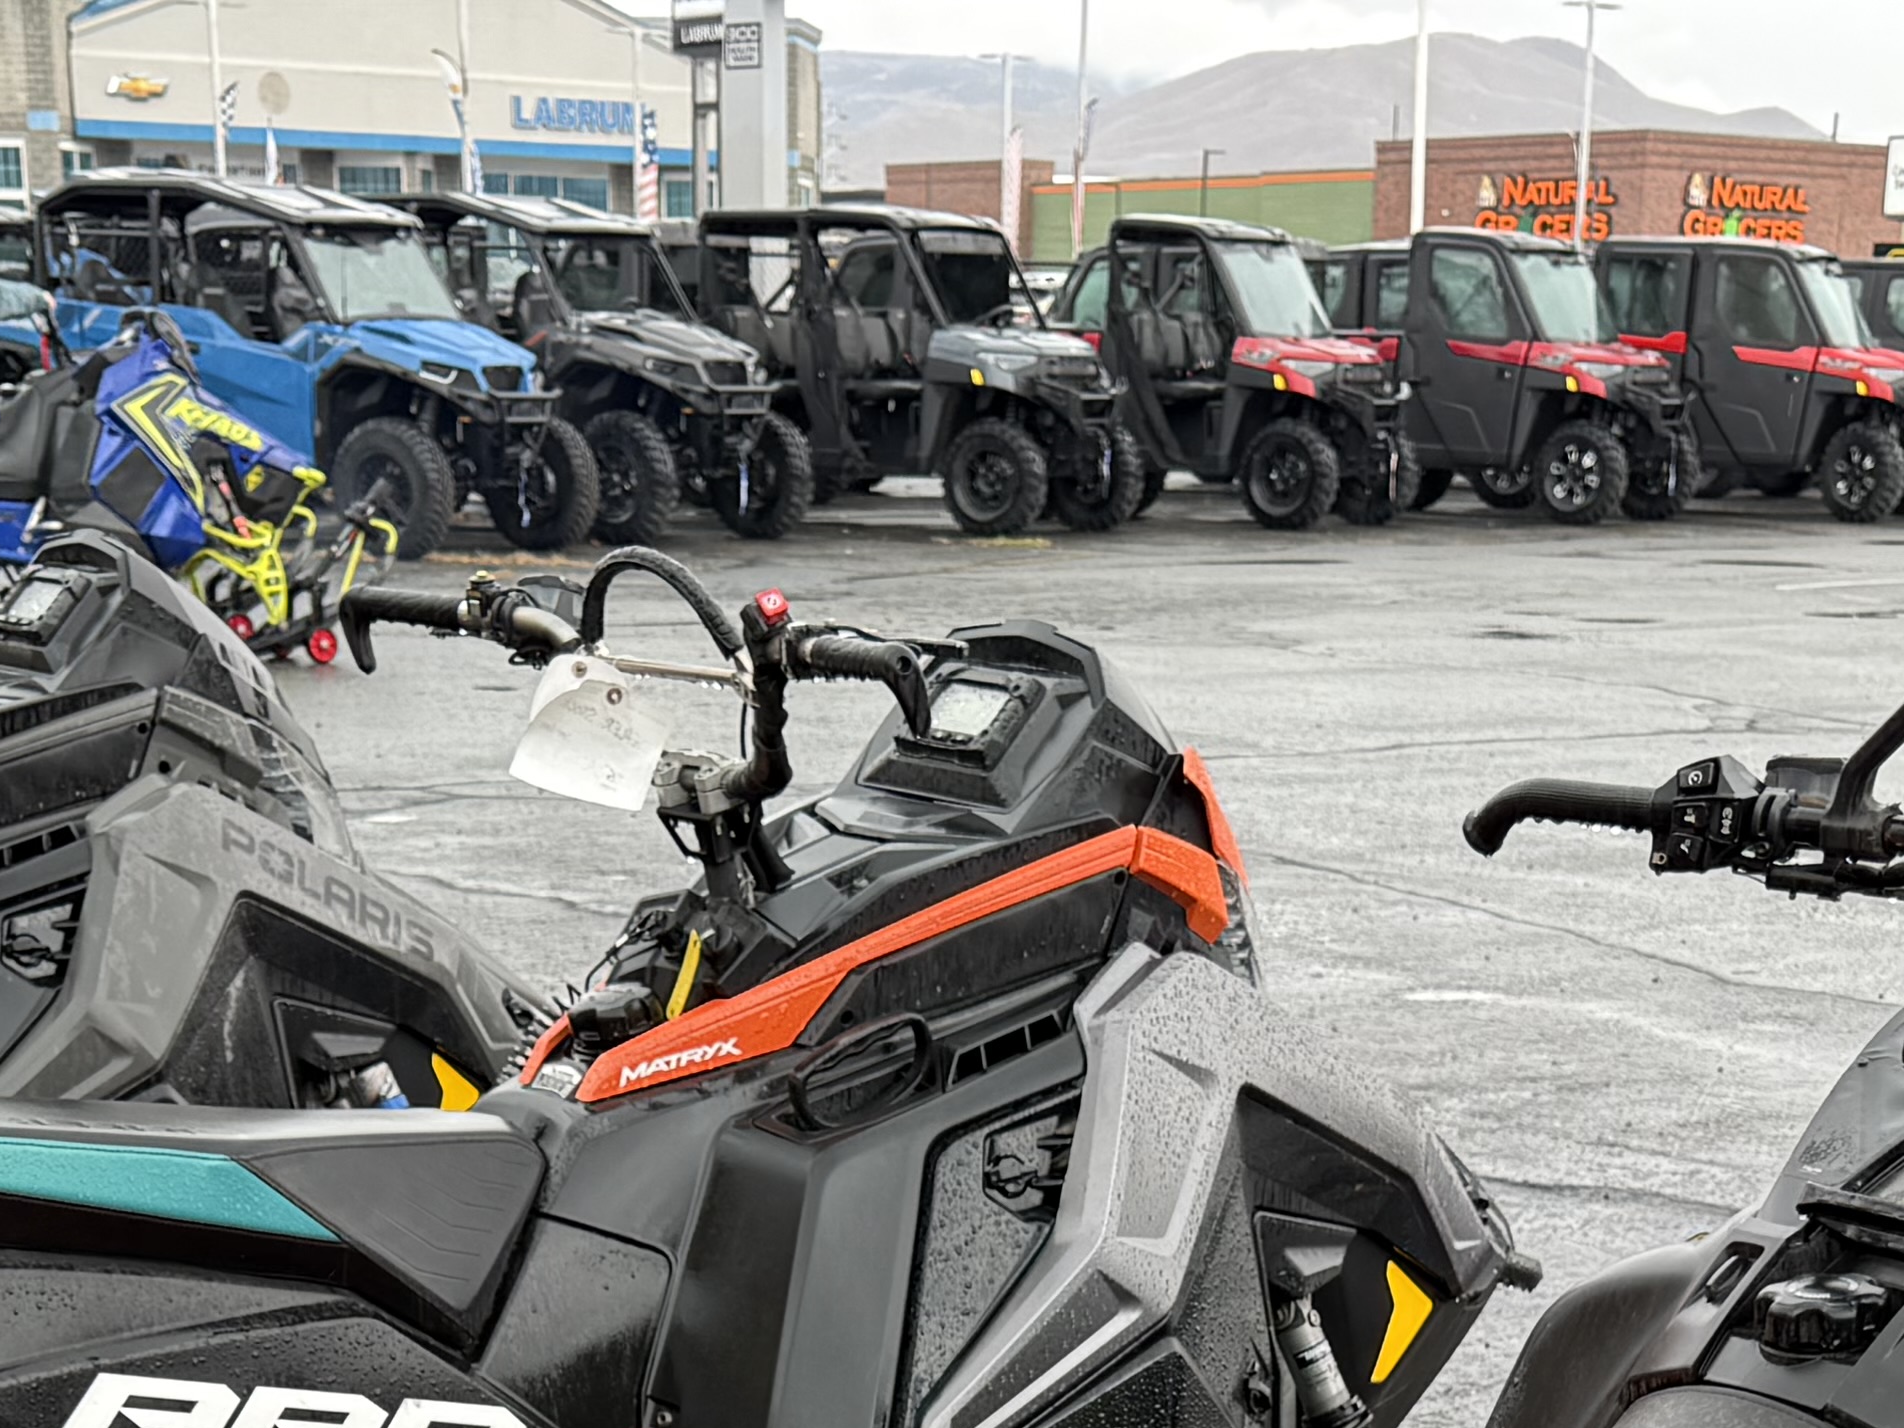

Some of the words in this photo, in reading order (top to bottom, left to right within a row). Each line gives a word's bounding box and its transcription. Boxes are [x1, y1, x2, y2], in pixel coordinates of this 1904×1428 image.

[1711, 176, 1812, 213] NATURAL
[222, 817, 435, 962] POLARIS
[618, 1036, 743, 1088] MATRYX
